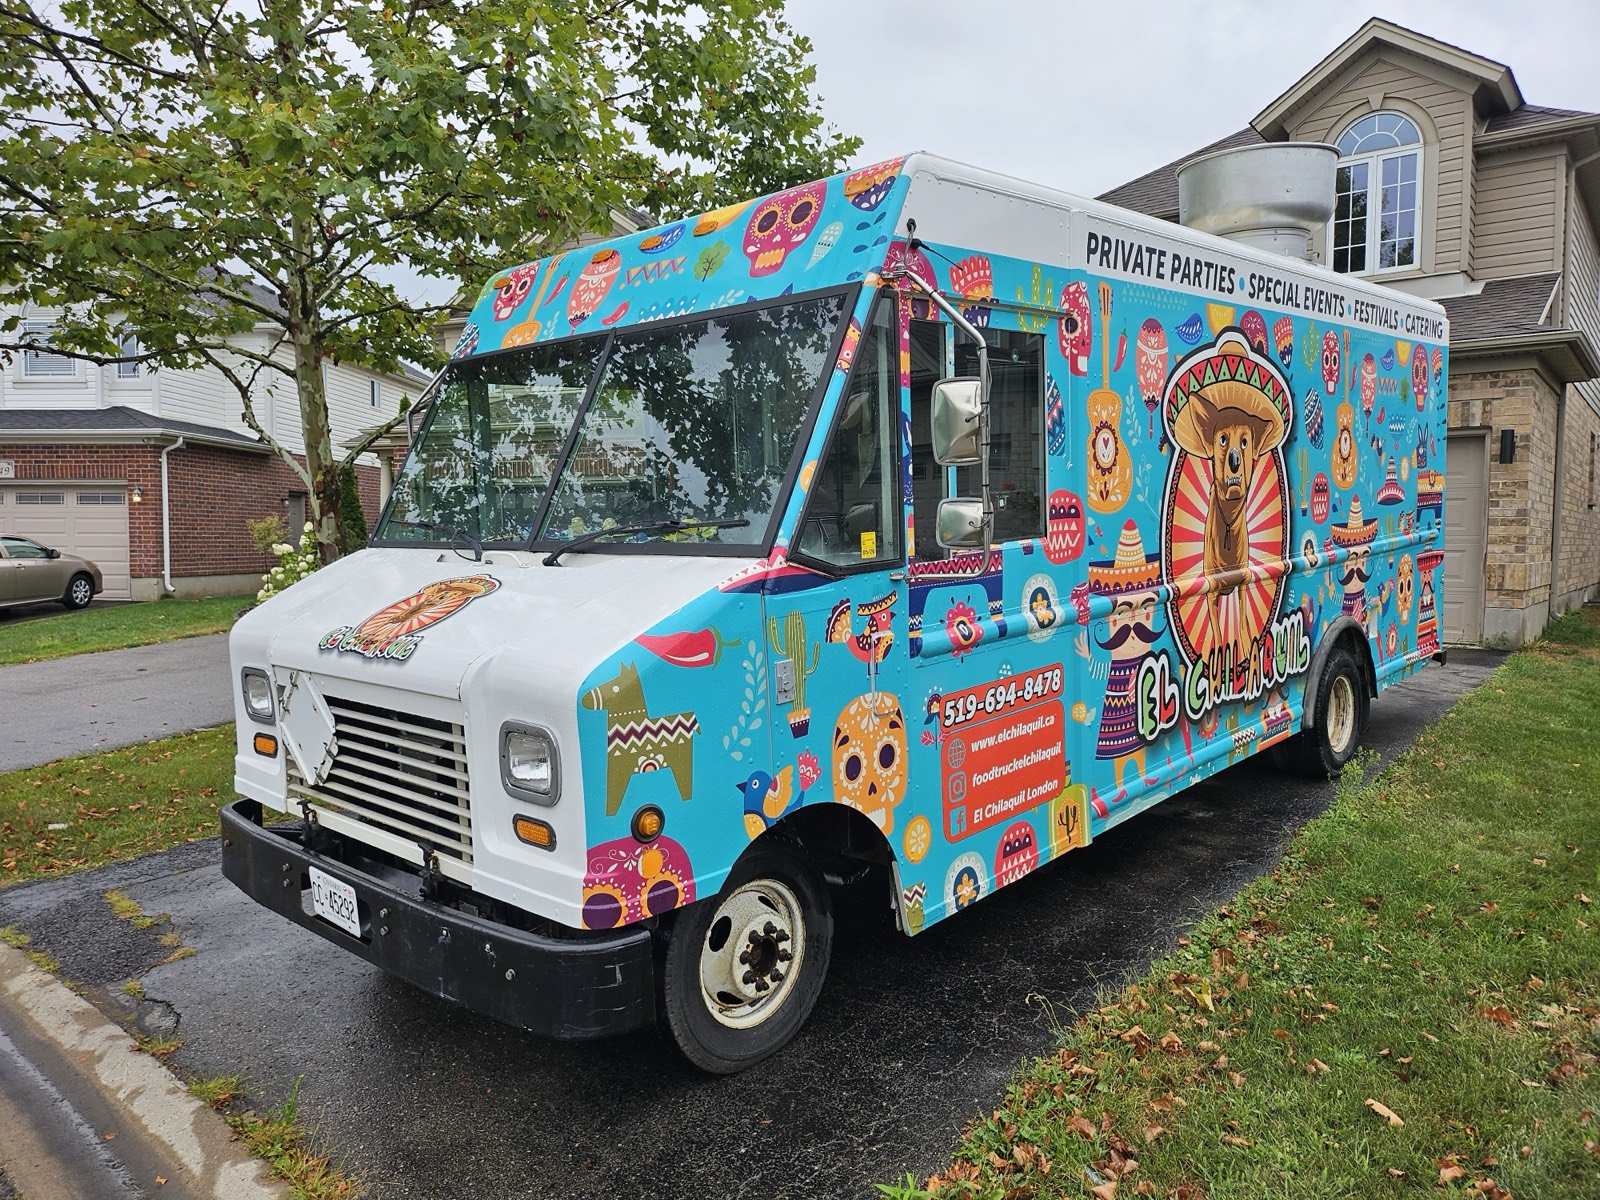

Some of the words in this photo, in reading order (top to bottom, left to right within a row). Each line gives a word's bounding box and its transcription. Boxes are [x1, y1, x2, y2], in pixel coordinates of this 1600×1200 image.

[1087, 231, 1166, 280] PRIVATE
[1170, 252, 1235, 295] PARTIES
[1248, 273, 1301, 307] SPECIAL
[1304, 287, 1346, 319] EVENTS
[1353, 299, 1399, 331] FESTIVALS
[1405, 313, 1444, 339] CATERING
[943, 668, 1062, 727] 519-694-8478
[970, 714, 1055, 753] www.elchilaquil.ca
[972, 741, 1062, 788] foodtruckelchilaquil
[973, 807, 984, 824] El
[985, 790, 1026, 818] Chilaquil
[1026, 778, 1058, 800] London
